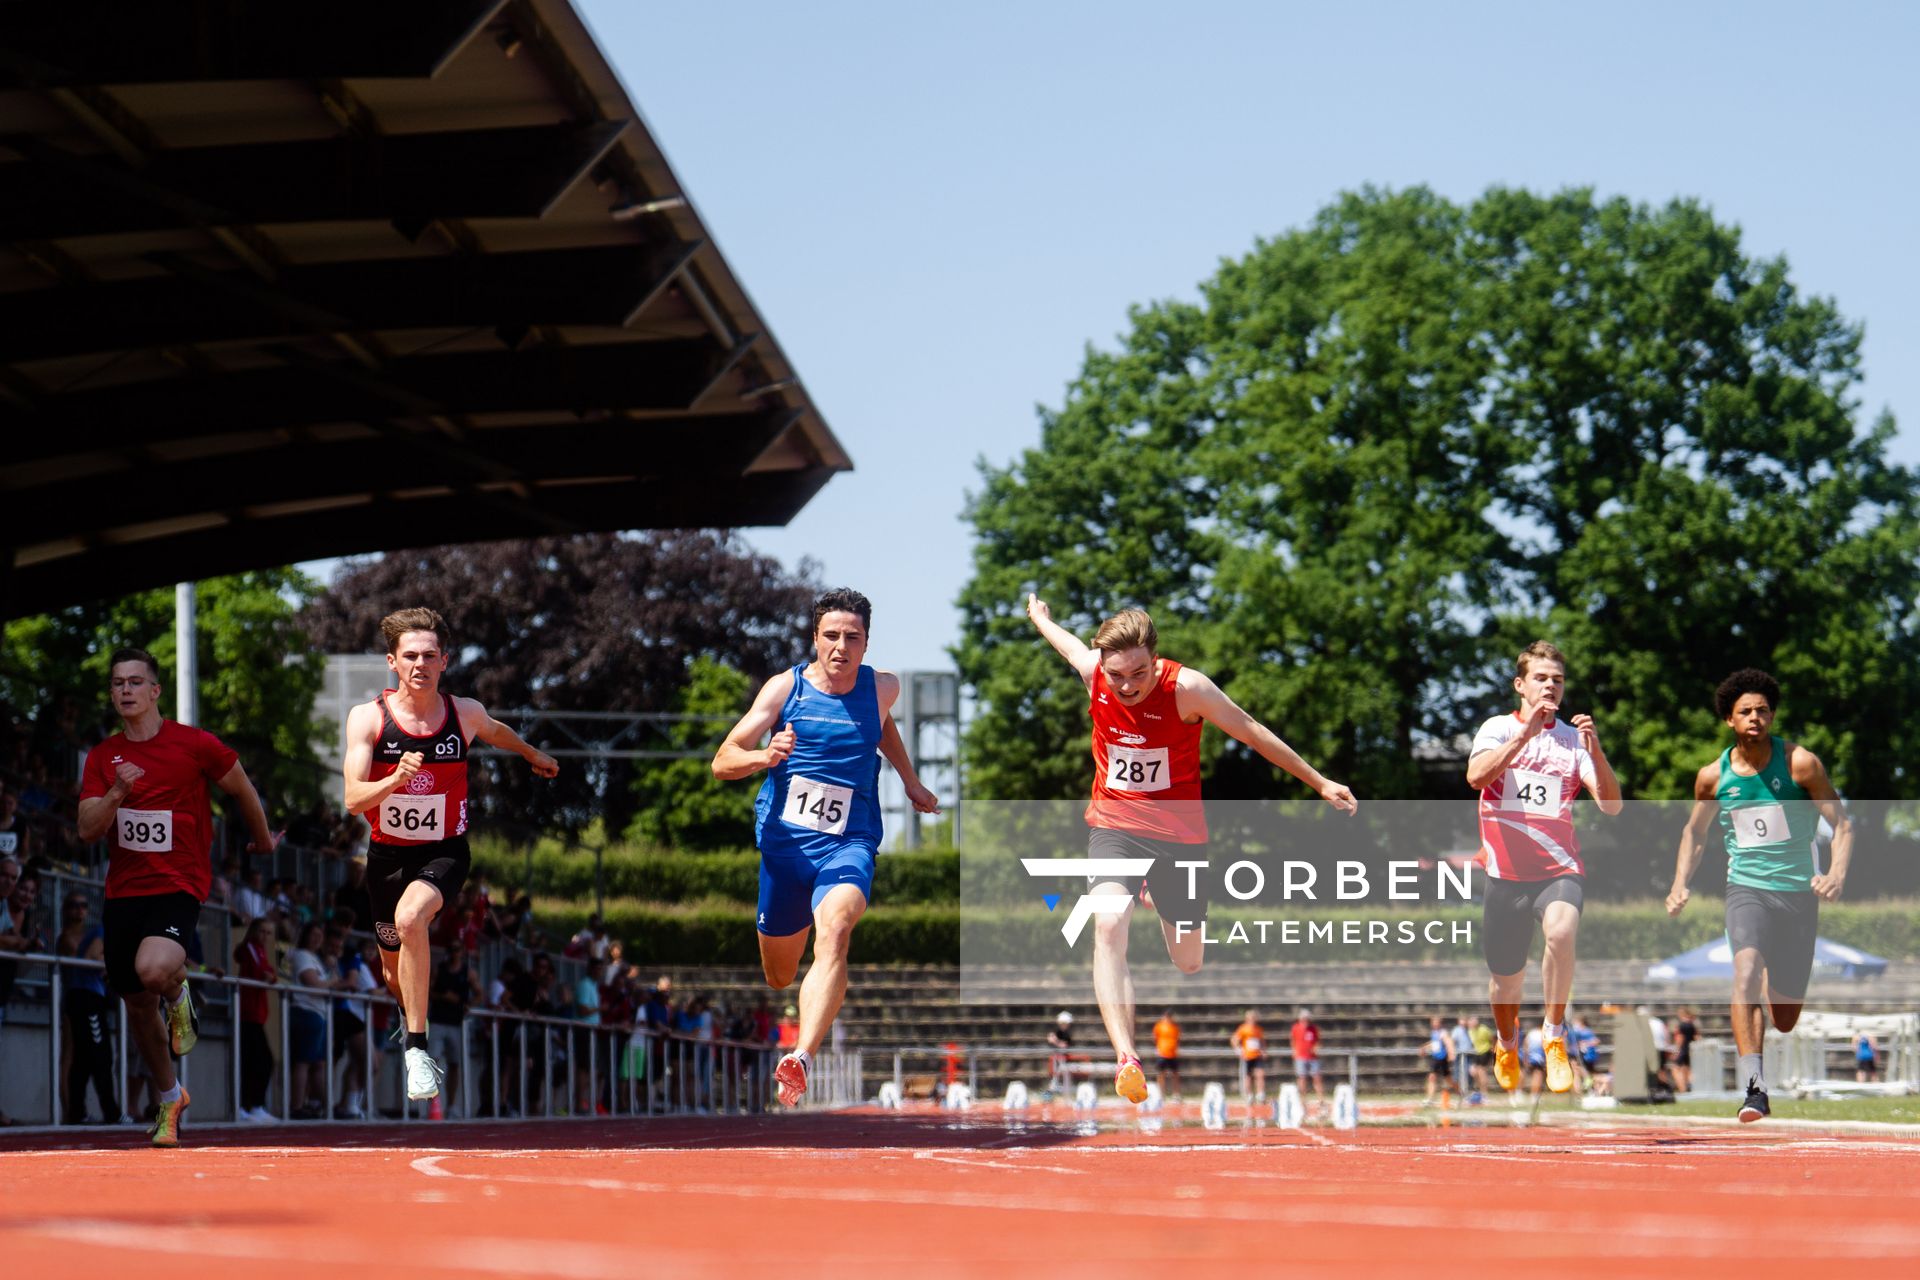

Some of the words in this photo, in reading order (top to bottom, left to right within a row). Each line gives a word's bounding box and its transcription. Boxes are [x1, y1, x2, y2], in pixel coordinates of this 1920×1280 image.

[435, 742, 454, 754] OS
[1115, 758, 1162, 783] 287
[1516, 783, 1547, 806] 43
[387, 806, 438, 831] 364
[797, 791, 844, 824] 145
[123, 820, 167, 844] 393
[1754, 818, 1768, 838] 9
